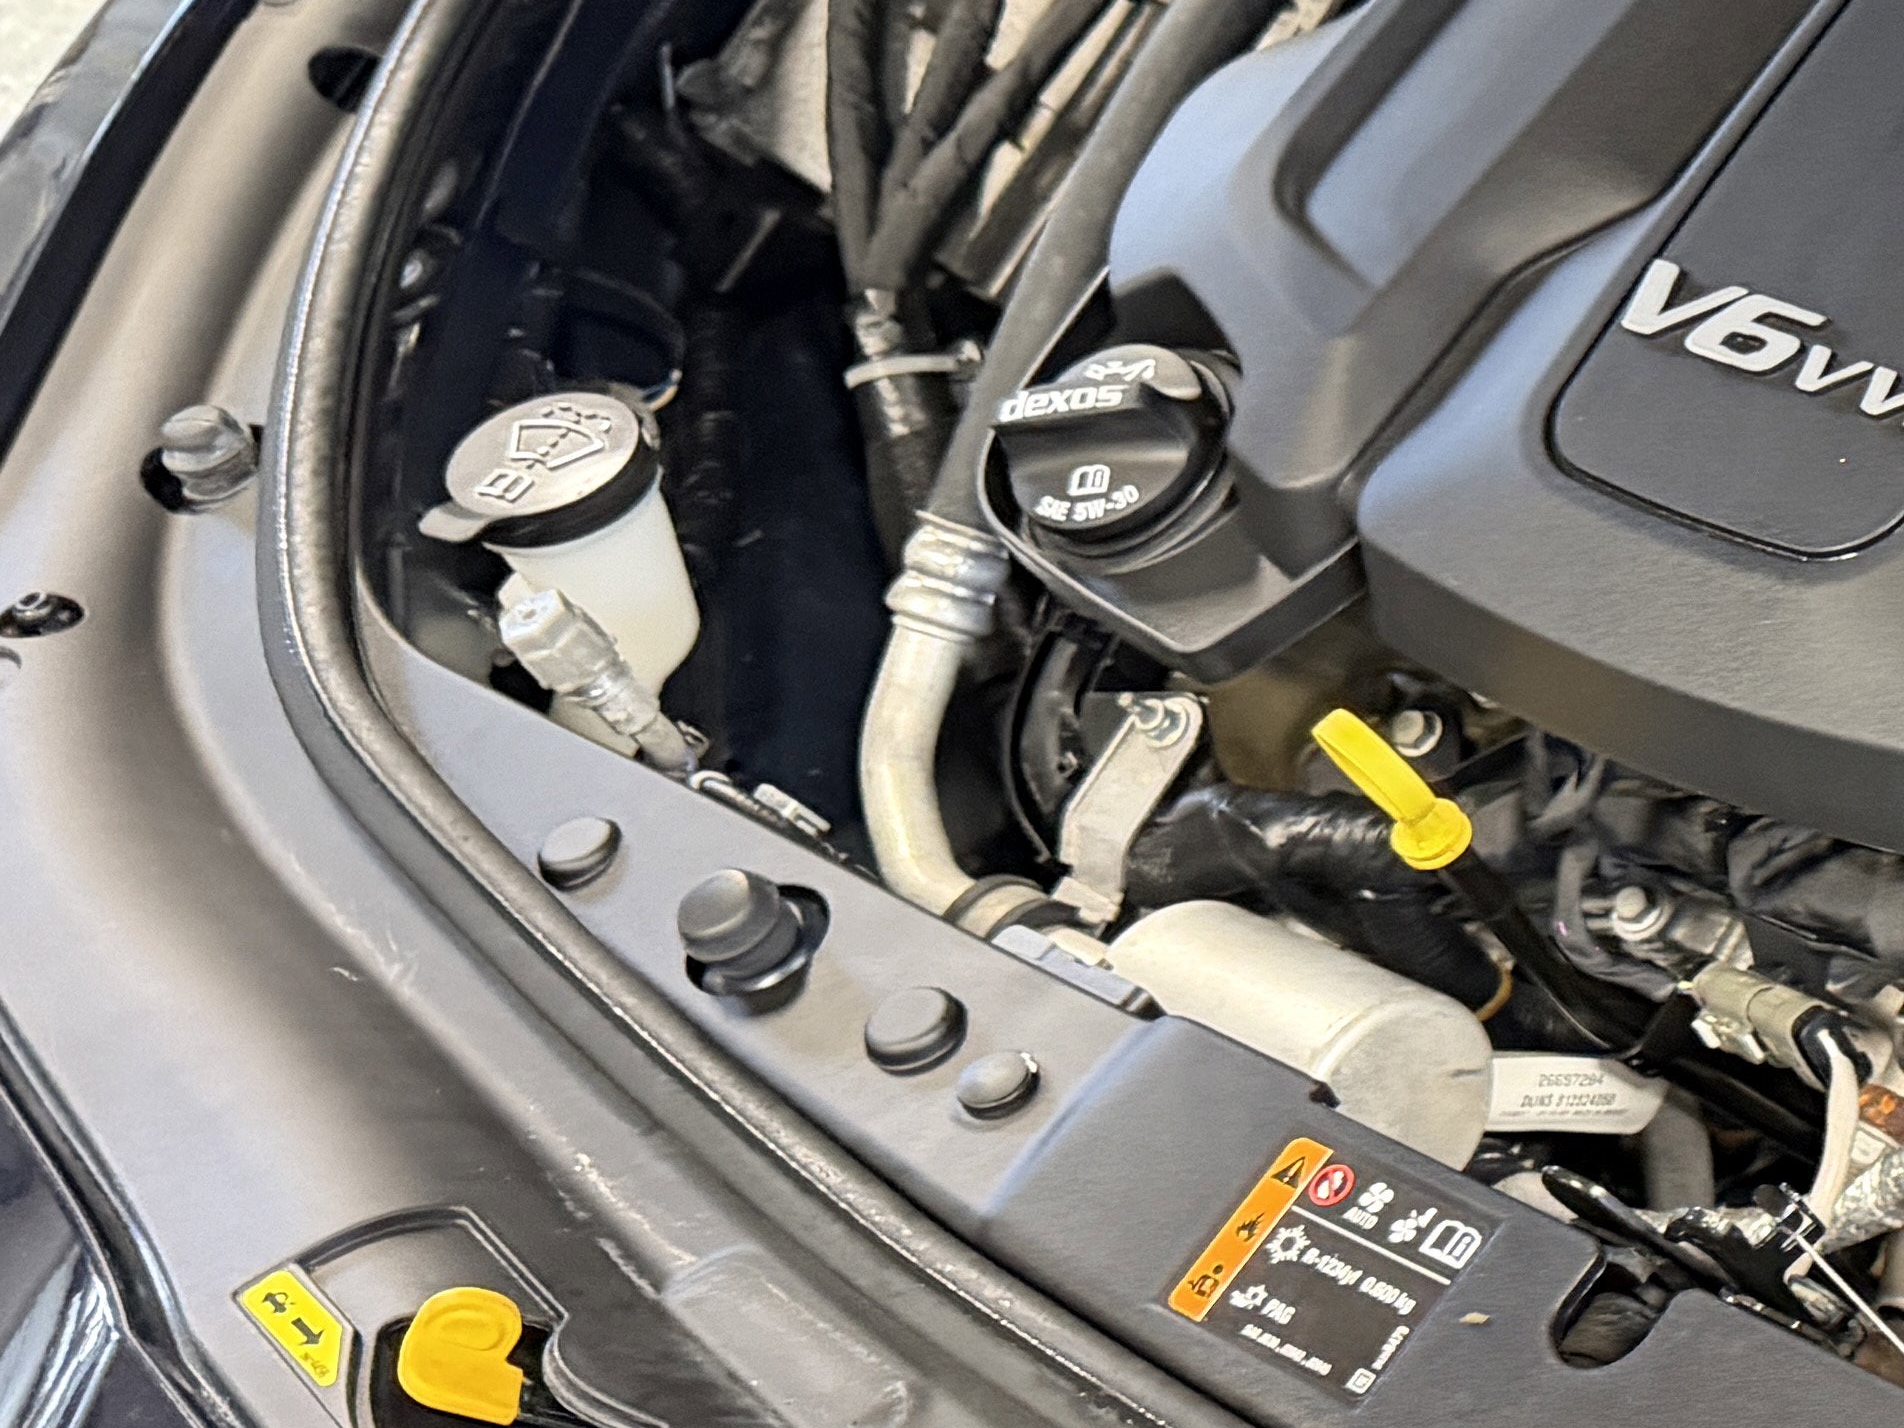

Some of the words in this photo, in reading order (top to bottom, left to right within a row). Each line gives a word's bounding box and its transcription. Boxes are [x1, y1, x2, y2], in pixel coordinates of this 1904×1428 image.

[1620, 258, 1829, 374] V6
[998, 383, 1130, 424] dexos
[1035, 494, 1071, 522] SAE
[1071, 484, 1140, 523] 5W-30
[1342, 1205, 1380, 1230] AUTO
[1260, 1298, 1297, 1325] PAG
[1393, 1292, 1417, 1315] kg
